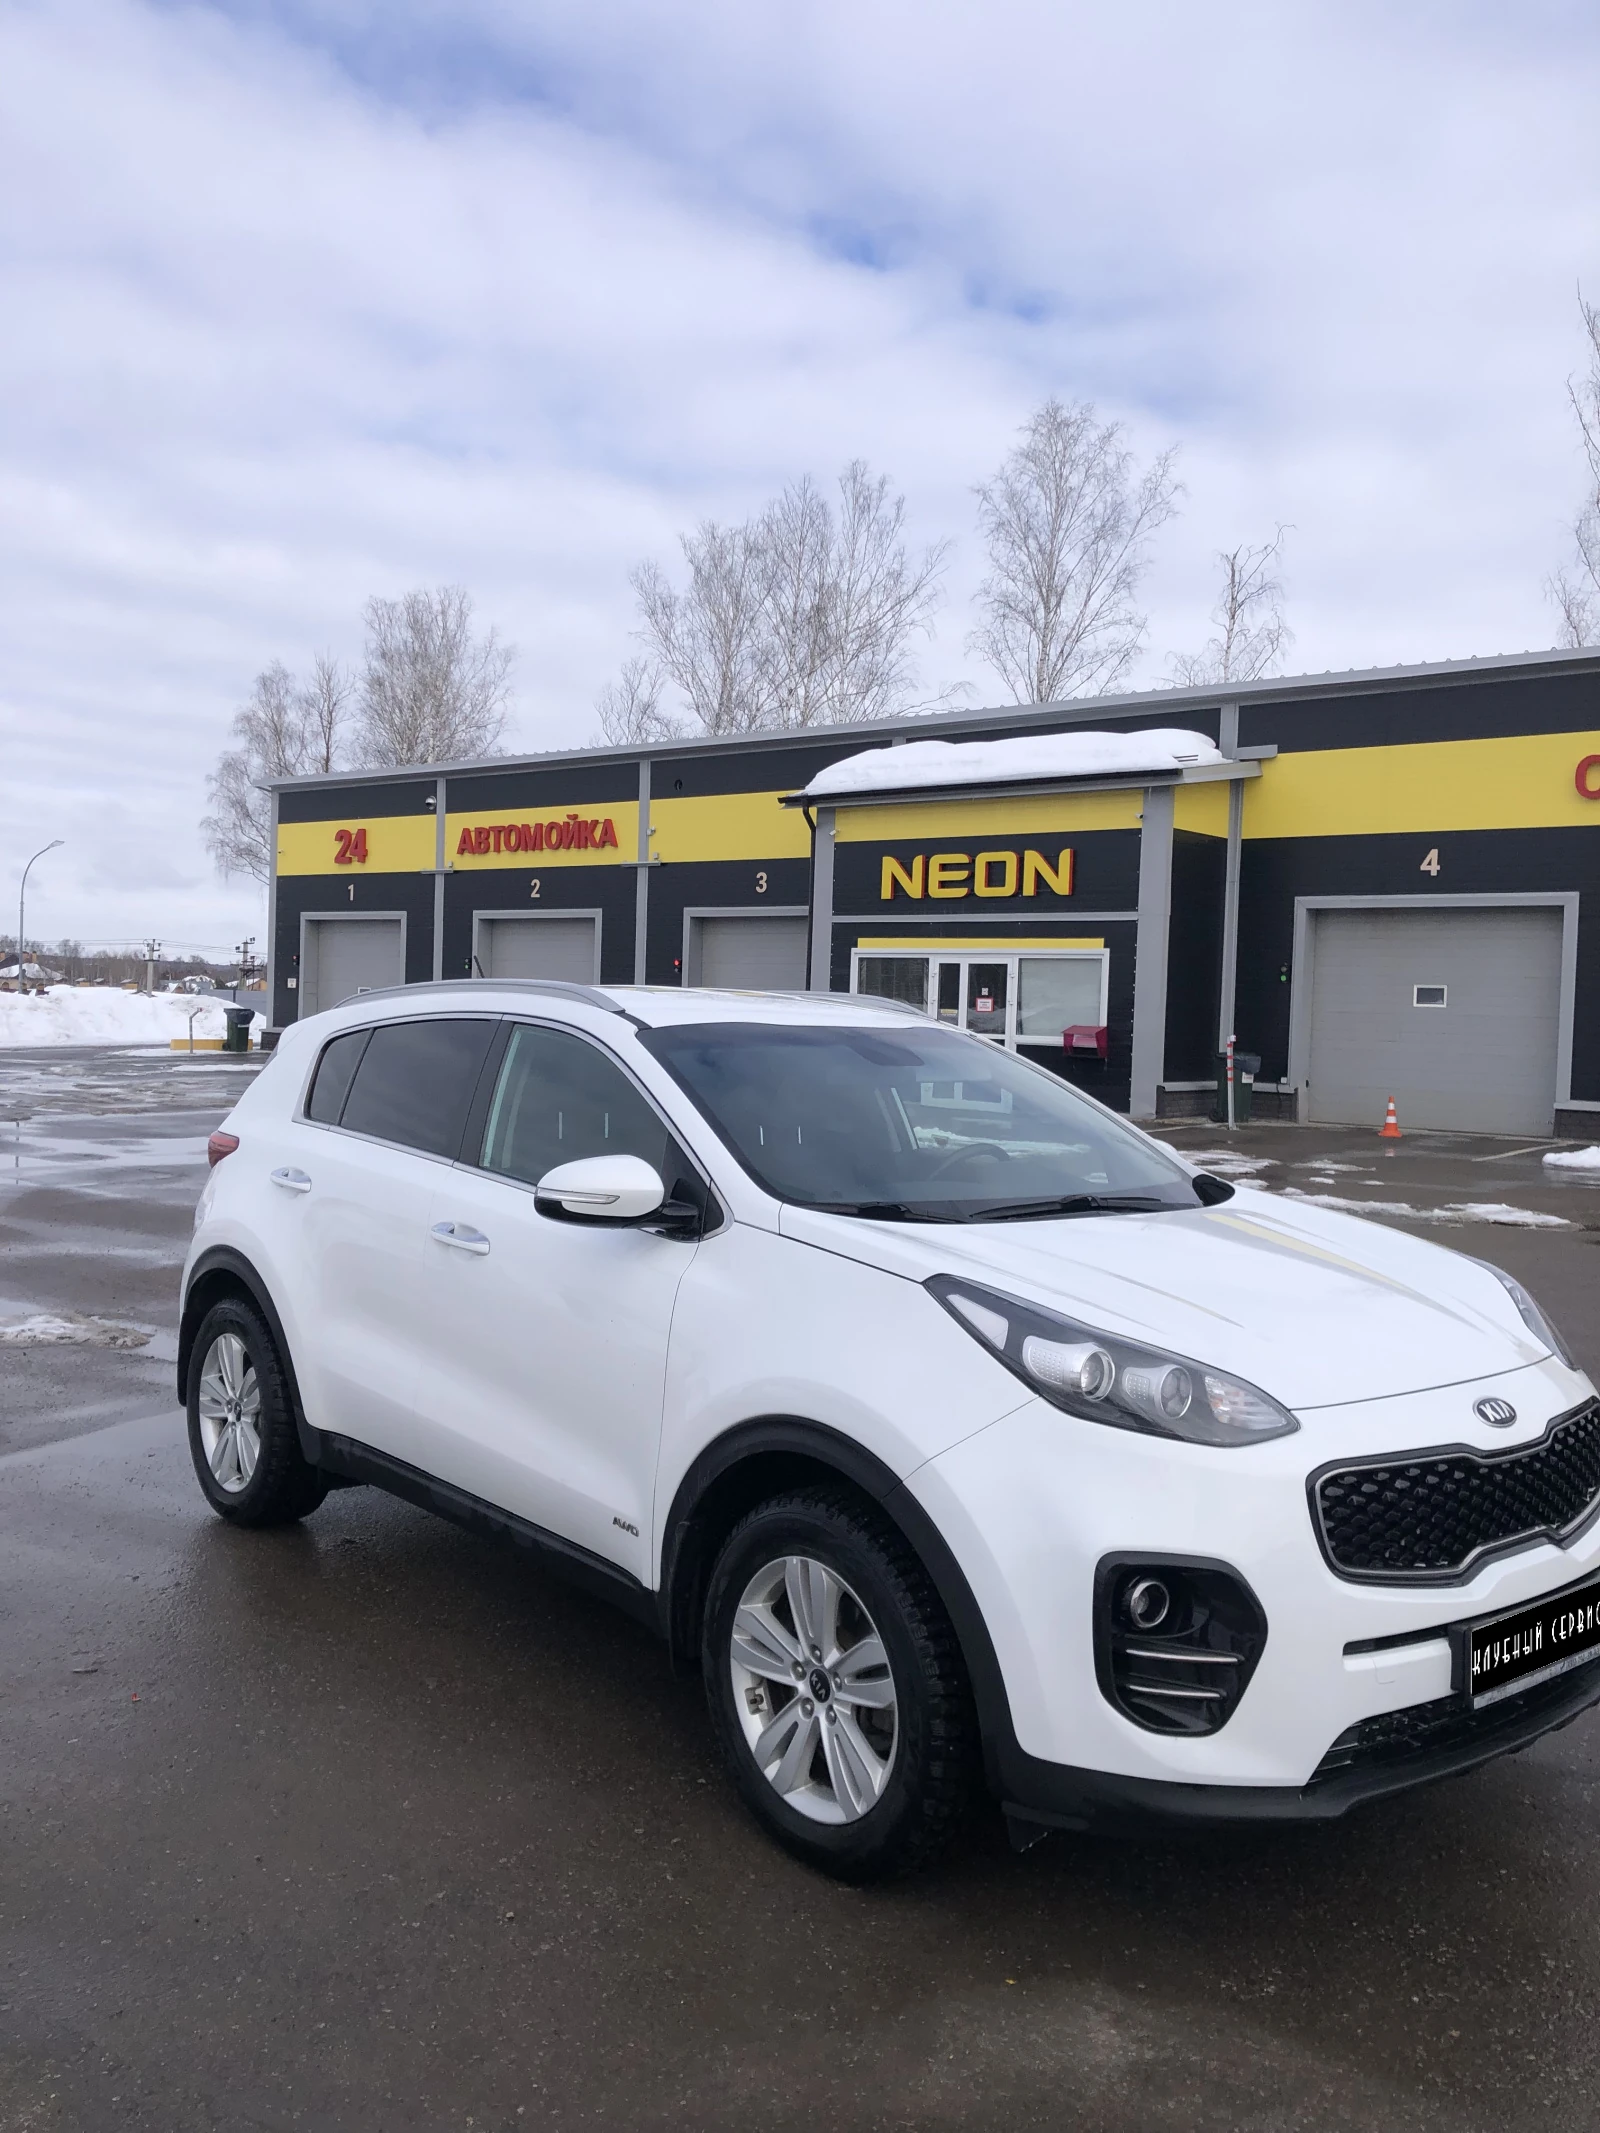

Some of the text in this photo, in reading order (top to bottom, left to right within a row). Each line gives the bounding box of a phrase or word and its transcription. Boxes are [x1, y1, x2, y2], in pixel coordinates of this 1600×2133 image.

[457, 813, 618, 855] АВТОМОЙКА
[334, 828, 368, 864] 24
[1420, 849, 1440, 876] 4
[756, 872, 768, 893] 3
[881, 848, 1074, 900] NEON
[347, 884, 354, 901] 1
[530, 879, 541, 898] 2
[1479, 1400, 1515, 1422] KIA
[612, 1516, 640, 1538] AWD
